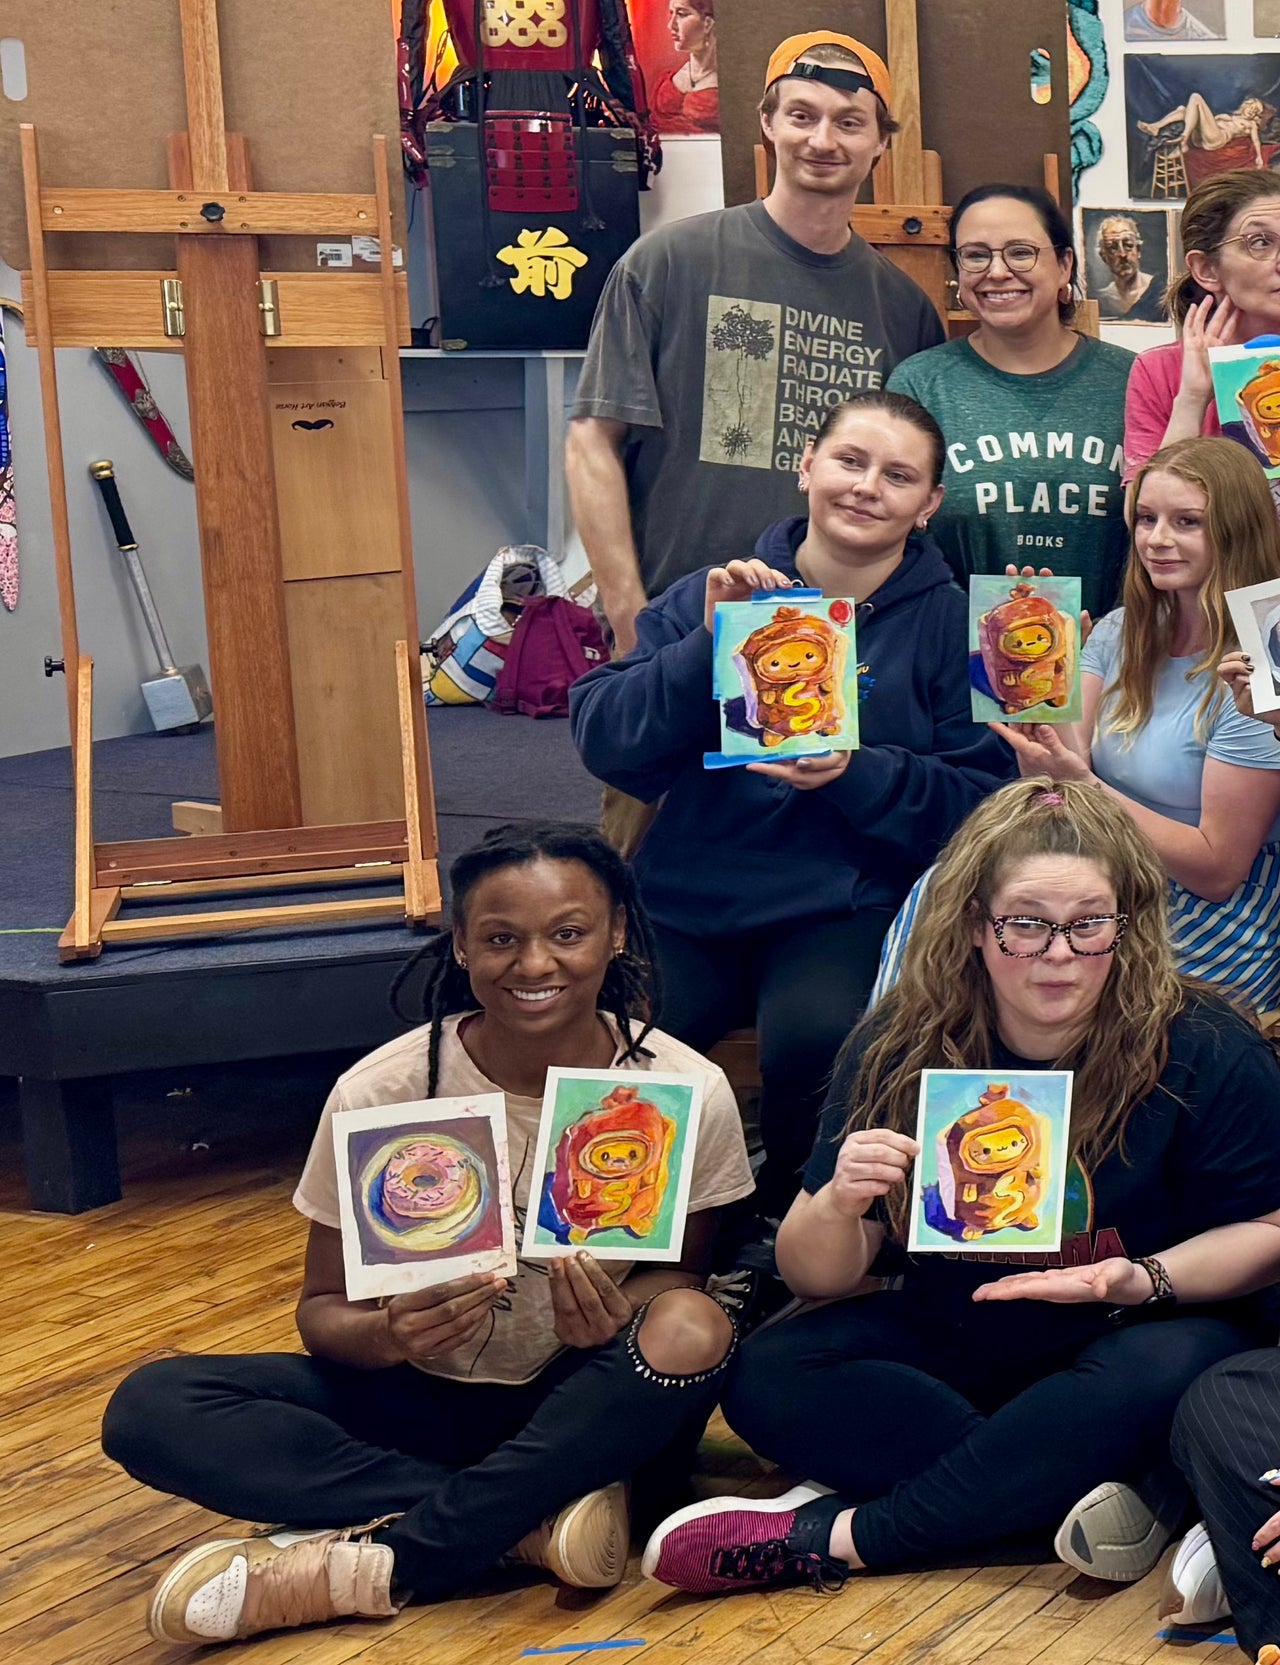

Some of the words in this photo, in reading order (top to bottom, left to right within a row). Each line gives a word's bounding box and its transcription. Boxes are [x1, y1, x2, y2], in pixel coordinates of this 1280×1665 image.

[496, 227, 589, 300] 前
[786, 306, 863, 341] DIVINE
[784, 330, 882, 366] ENERGY
[783, 354, 882, 390] RADIATE
[781, 379, 850, 407] THRO
[779, 403, 827, 430] BEA
[975, 481, 1109, 516] PLACE
[1017, 535, 1064, 548] BOOKS
